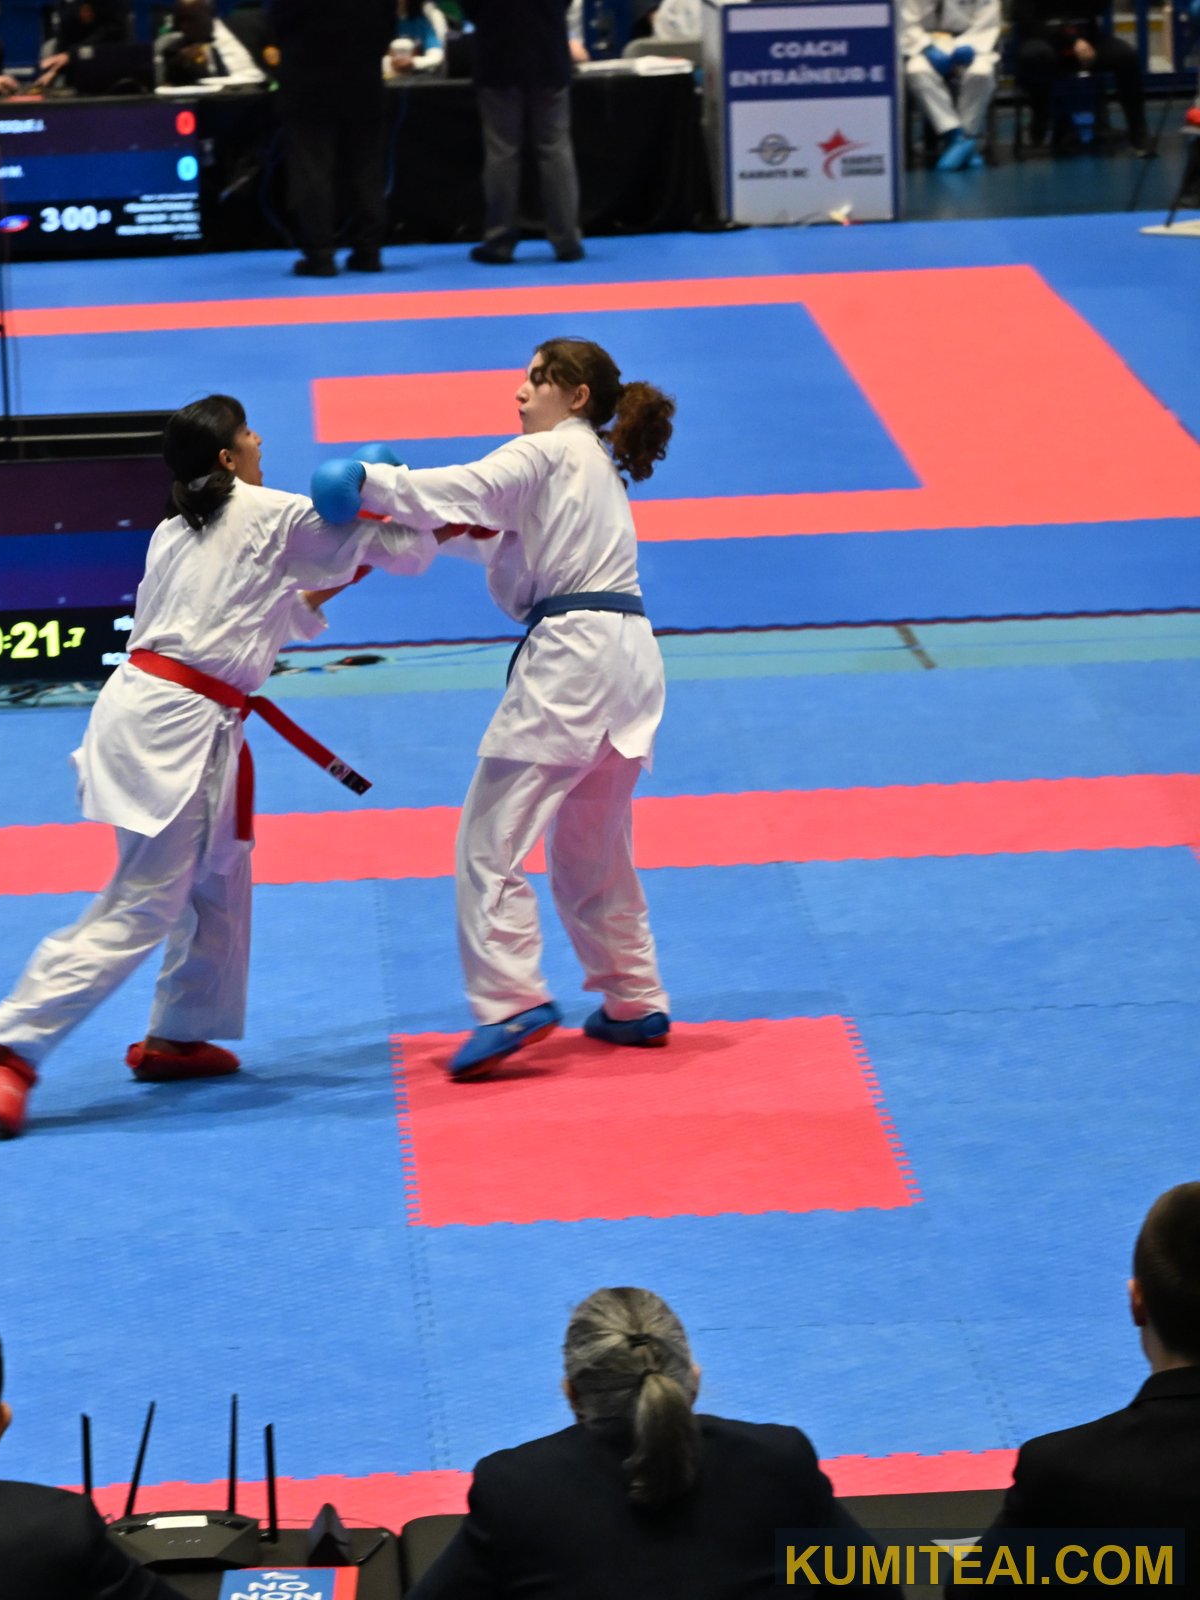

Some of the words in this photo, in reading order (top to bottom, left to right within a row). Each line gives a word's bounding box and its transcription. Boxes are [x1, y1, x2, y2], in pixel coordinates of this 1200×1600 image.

[770, 40, 848, 58] COACH
[176, 110, 196, 135] 0
[177, 155, 198, 181] 0
[230, 1591, 323, 1600] NON
[247, 1581, 310, 1592] NO
